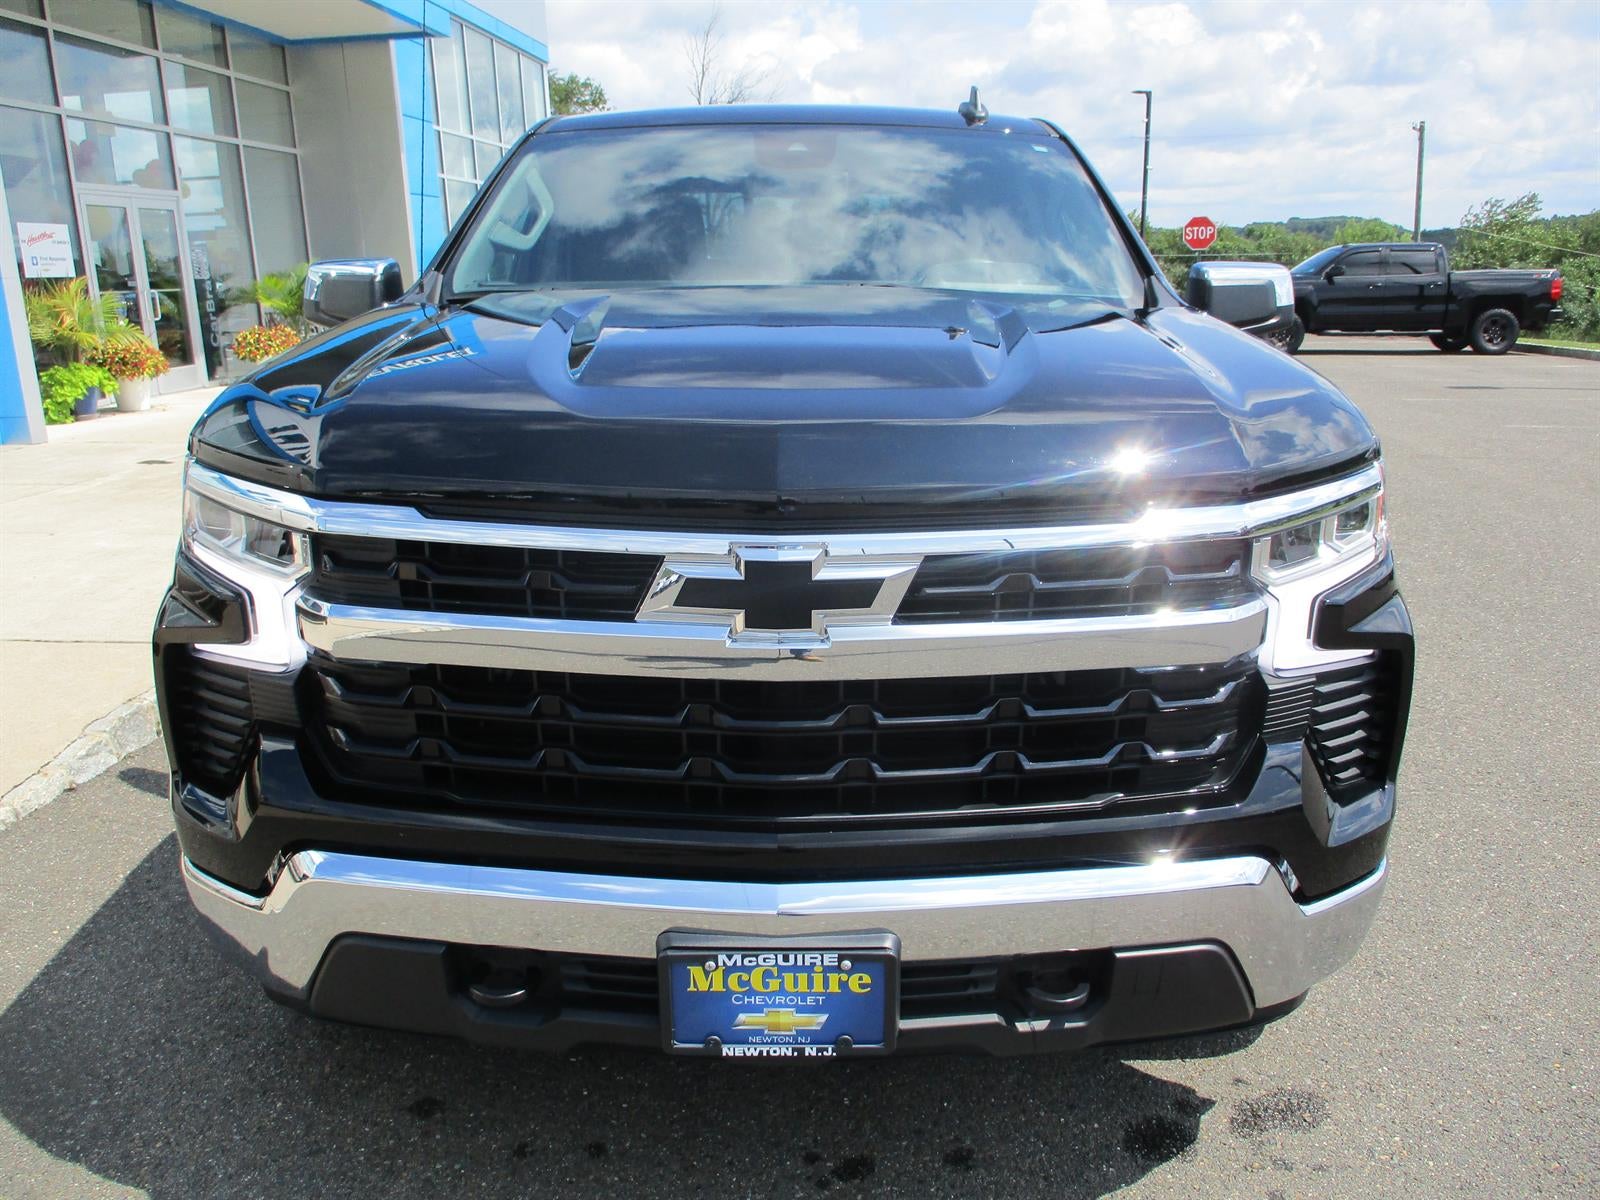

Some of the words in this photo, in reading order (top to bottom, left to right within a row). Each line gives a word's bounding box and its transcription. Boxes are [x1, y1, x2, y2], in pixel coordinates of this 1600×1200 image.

[1185, 226, 1214, 240] STOP
[205, 280, 220, 348] CarBra
[718, 953, 839, 966] McGUIRE
[687, 966, 872, 993] McGuire
[731, 994, 826, 1005] CHEVROLET
[748, 1036, 796, 1044] NEWTON,
[805, 1047, 837, 1057] N.J.
